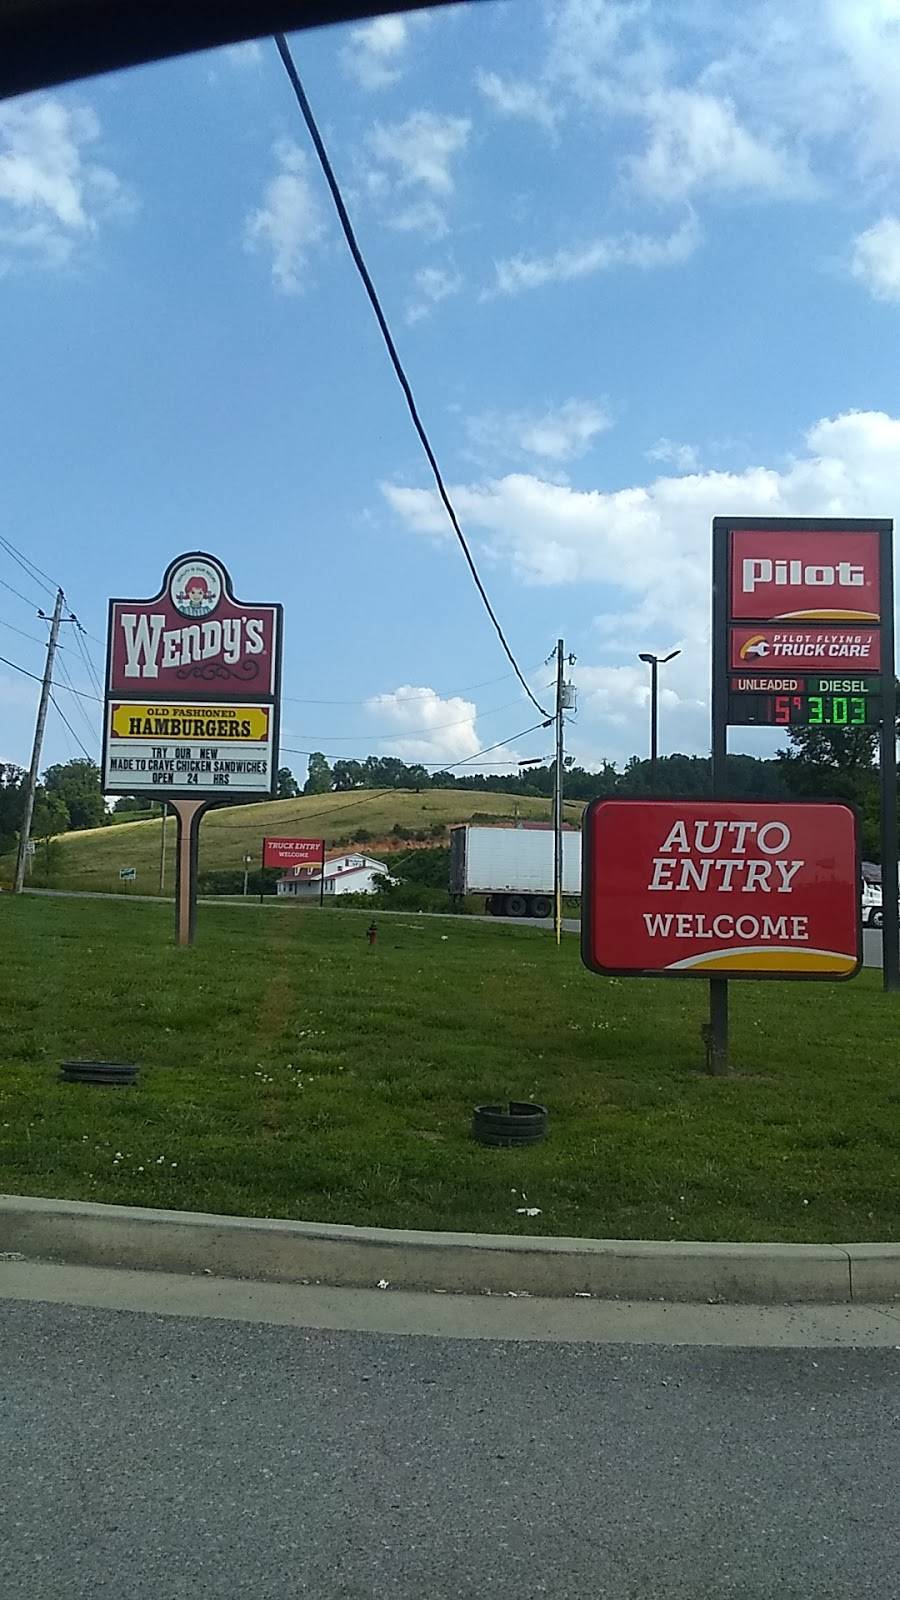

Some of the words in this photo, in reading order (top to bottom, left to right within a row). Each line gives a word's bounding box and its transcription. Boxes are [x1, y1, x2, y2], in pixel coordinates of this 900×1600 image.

[742, 558, 865, 593] Pilot
[773, 634, 811, 643] PILOT
[816, 634, 862, 644] FLYING
[866, 635, 872, 644] J
[772, 643, 825, 657] TRUCK
[828, 643, 870, 658] CARE
[738, 679, 798, 691] UNLEADED
[819, 680, 869, 692] DIESEL
[147, 707, 169, 715] OLD
[173, 708, 236, 718] FASHIONED
[808, 696, 865, 724] 3.03
[129, 717, 251, 737] HAMBURGERS
[152, 747, 167, 759] TRY
[175, 747, 191, 759] OUR
[199, 748, 218, 759] NEW
[110, 758, 133, 770] MADE
[135, 759, 146, 771] TO
[148, 759, 175, 771] CRAVE
[176, 760, 211, 772] CHICKEN
[213, 760, 268, 774] SANDWICHES
[152, 772, 174, 783] OPEN
[187, 773, 198, 784] 24
[213, 773, 230, 784] HRS
[658, 819, 792, 855] AUTO
[647, 858, 805, 893] ENTRY
[643, 913, 809, 940] WELCOME
